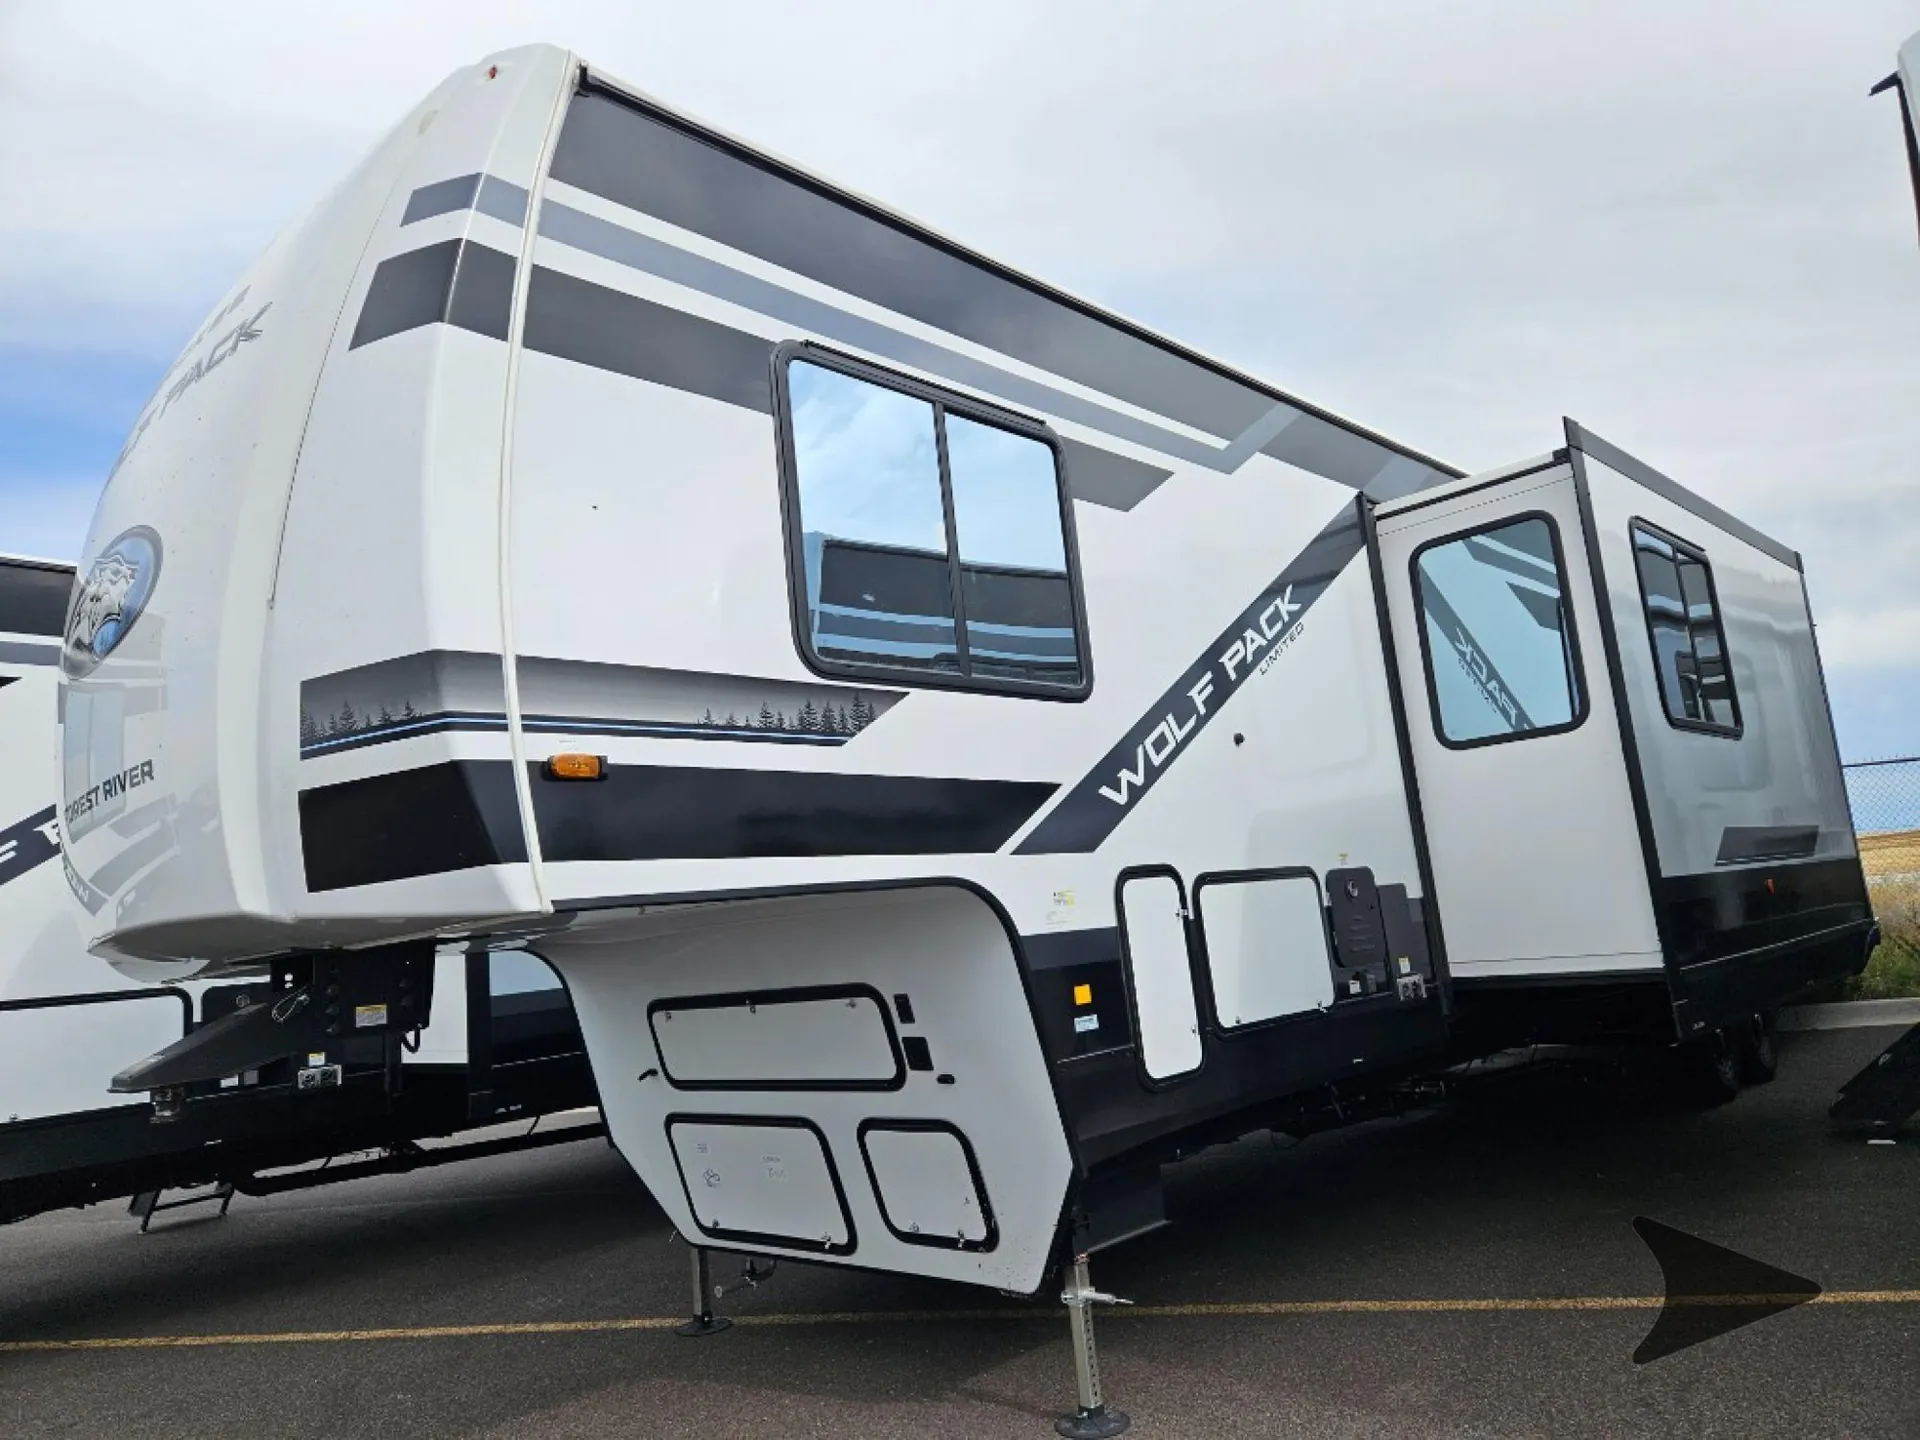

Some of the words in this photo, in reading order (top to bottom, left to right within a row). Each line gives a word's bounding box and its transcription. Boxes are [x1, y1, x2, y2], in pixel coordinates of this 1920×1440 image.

[1258, 621, 1305, 676] LIMITED
[1098, 671, 1214, 805] WOLF
[1218, 583, 1302, 681] PACK
[65, 785, 100, 823] OREST
[102, 759, 154, 801] RIVER
